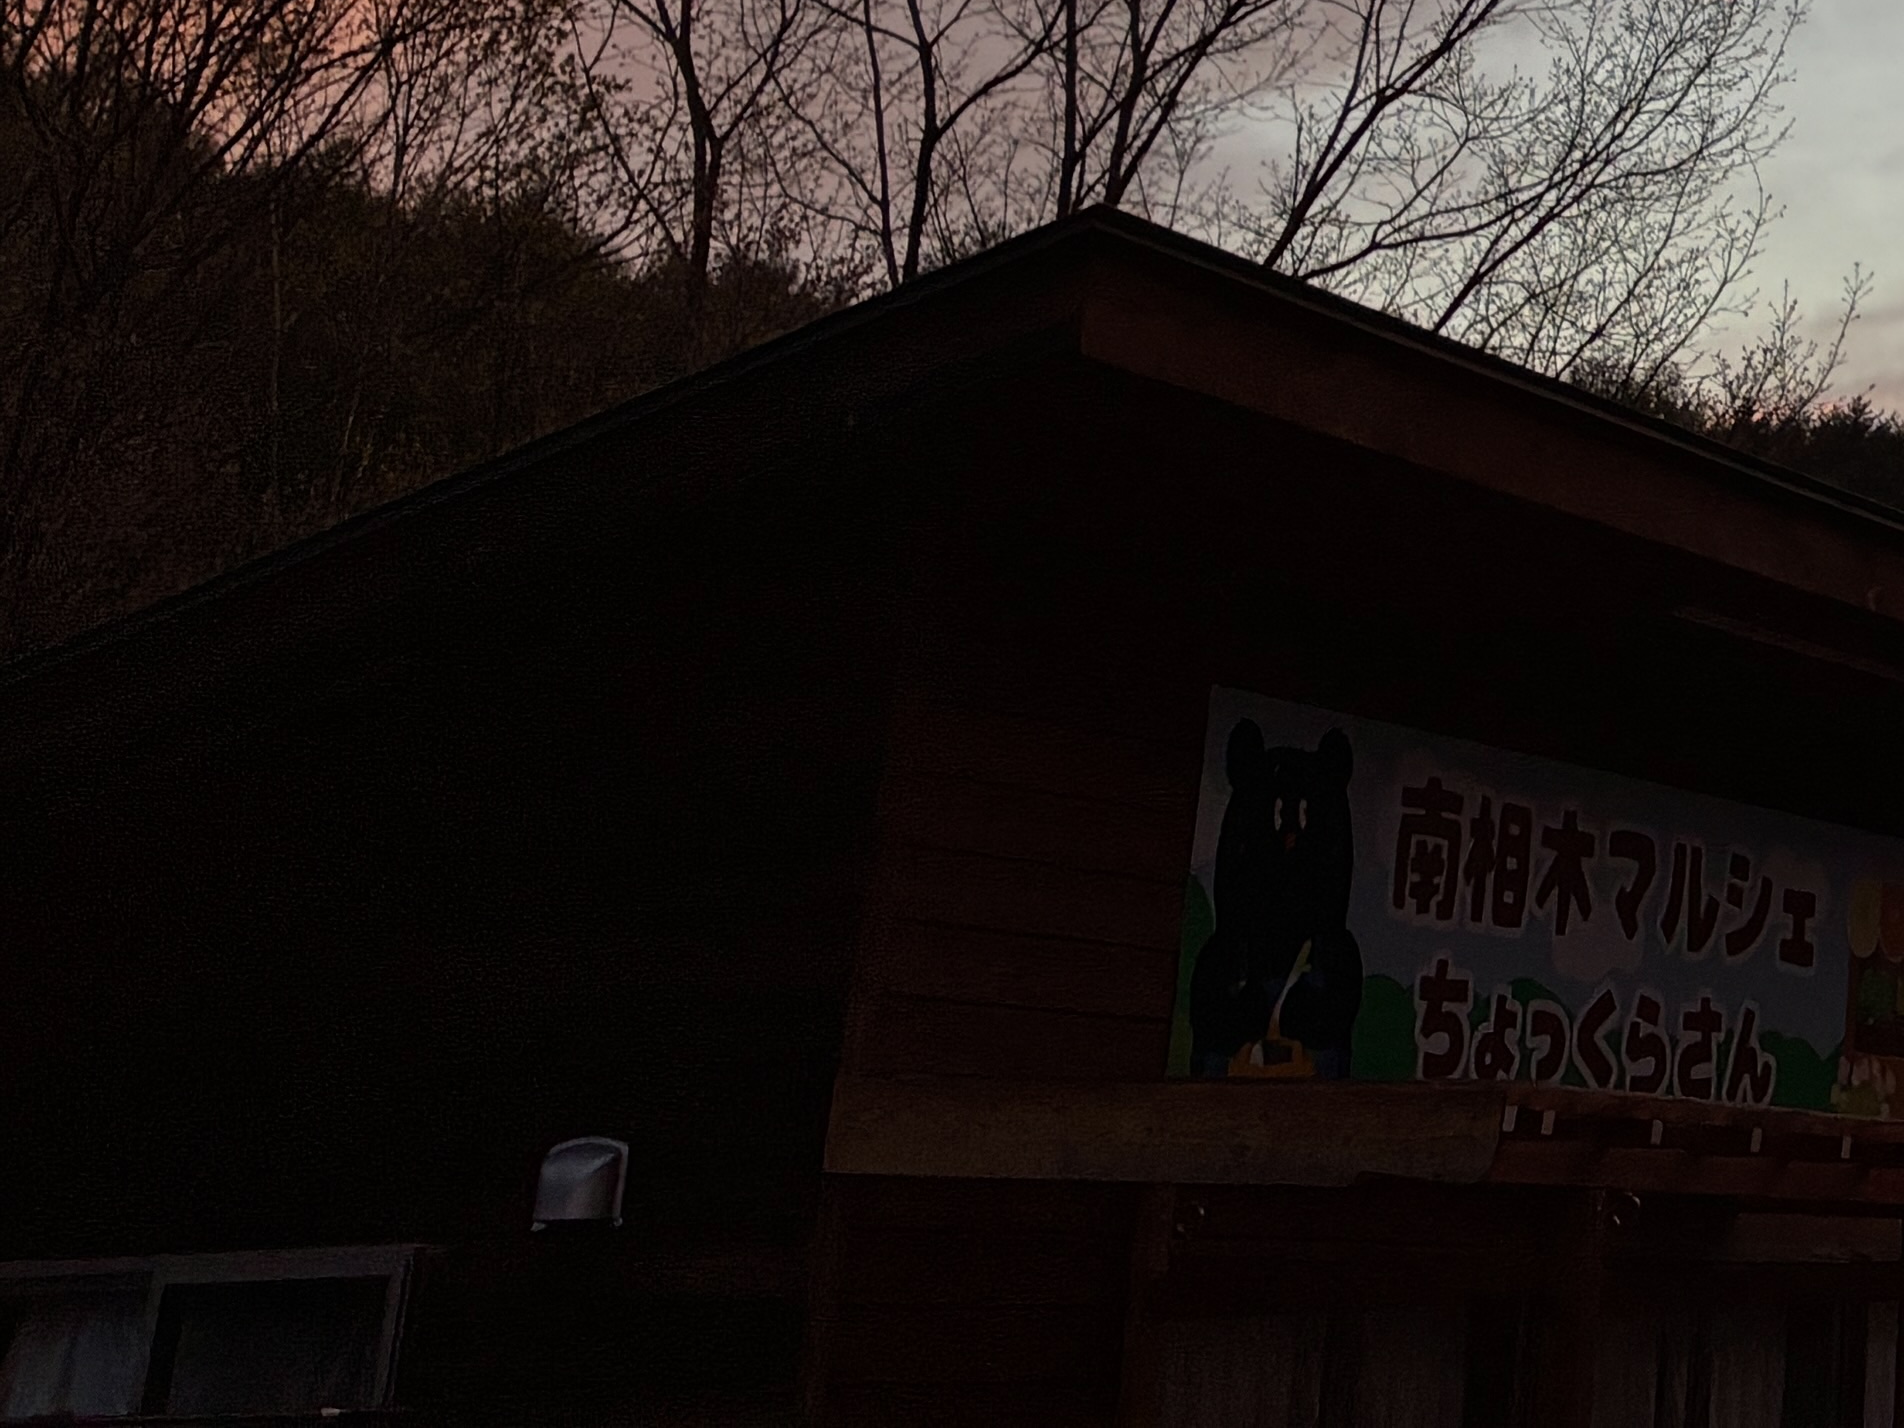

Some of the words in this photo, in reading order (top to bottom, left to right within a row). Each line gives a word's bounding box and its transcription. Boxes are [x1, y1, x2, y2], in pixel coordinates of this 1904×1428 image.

[1392, 776, 1817, 968] 南相木マルシェ
[1418, 957, 1775, 1105] ちょっくらさん
